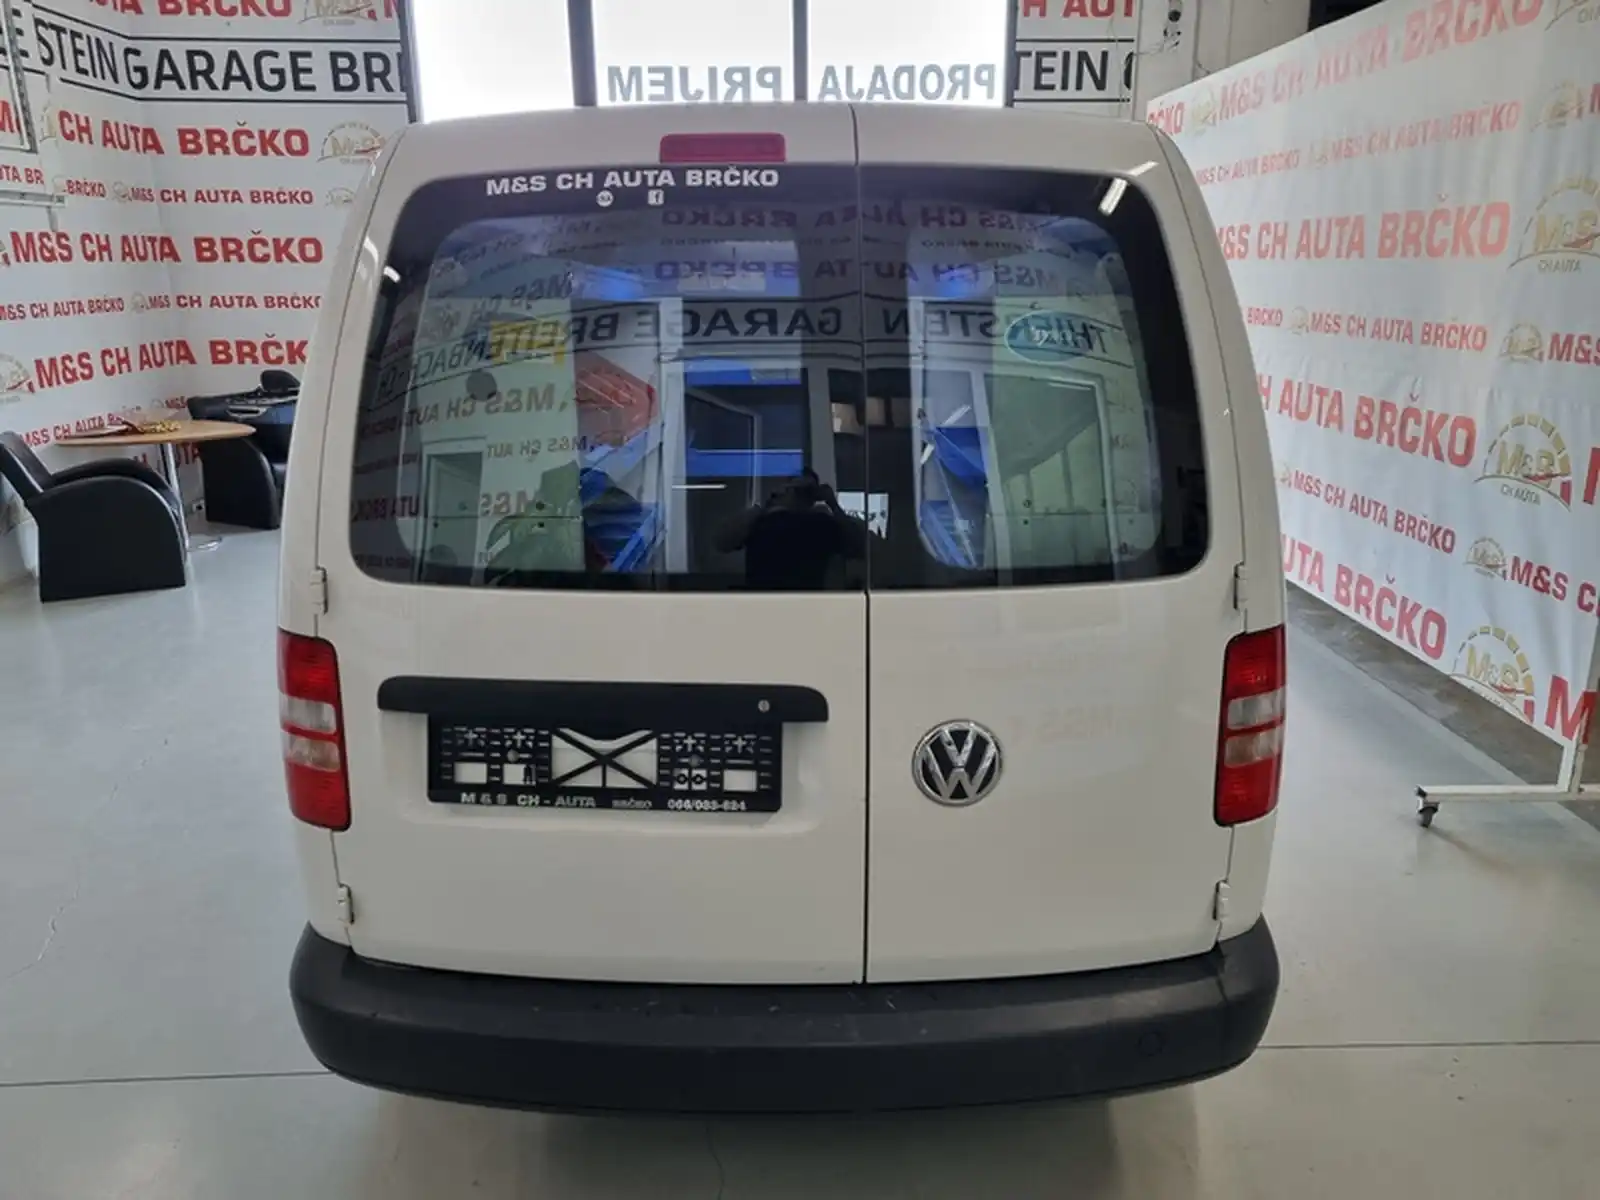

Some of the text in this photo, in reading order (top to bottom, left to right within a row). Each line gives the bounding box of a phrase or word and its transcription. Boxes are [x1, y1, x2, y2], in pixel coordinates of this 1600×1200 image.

[33, 16, 119, 83] STEIN
[124, 47, 317, 92] GARAGE
[58, 110, 94, 145] CH
[101, 119, 165, 155] AUTA
[177, 121, 310, 157] BRČKO
[160, 188, 187, 204] CH
[193, 189, 245, 205] AUTA
[486, 165, 780, 196] M&S CH AUTA BRČKO
[11, 229, 324, 264] M&S CH AUTA BRČKO
[1257, 220, 1289, 260] CH
[1295, 213, 1366, 260] AUTA
[1377, 192, 1510, 260] BRČKO
[30, 302, 49, 319] CH
[53, 300, 87, 317] AUTA
[176, 295, 203, 309] CH
[209, 295, 259, 309] AUTA
[1346, 315, 1367, 338] CH
[1371, 317, 1414, 345] AUTA
[34, 351, 95, 389] M&S
[101, 346, 132, 377] CH
[139, 339, 197, 372] AUTA
[1278, 377, 1344, 434] AUTA
[1354, 392, 1477, 469] BRČKO
[1293, 469, 1322, 498] M&S
[1323, 482, 1346, 509] CH
[1349, 493, 1388, 528] AUTA
[1511, 555, 1569, 602] M&S
[1577, 581, 1600, 618] C
[1334, 562, 1448, 661] BRČKO
